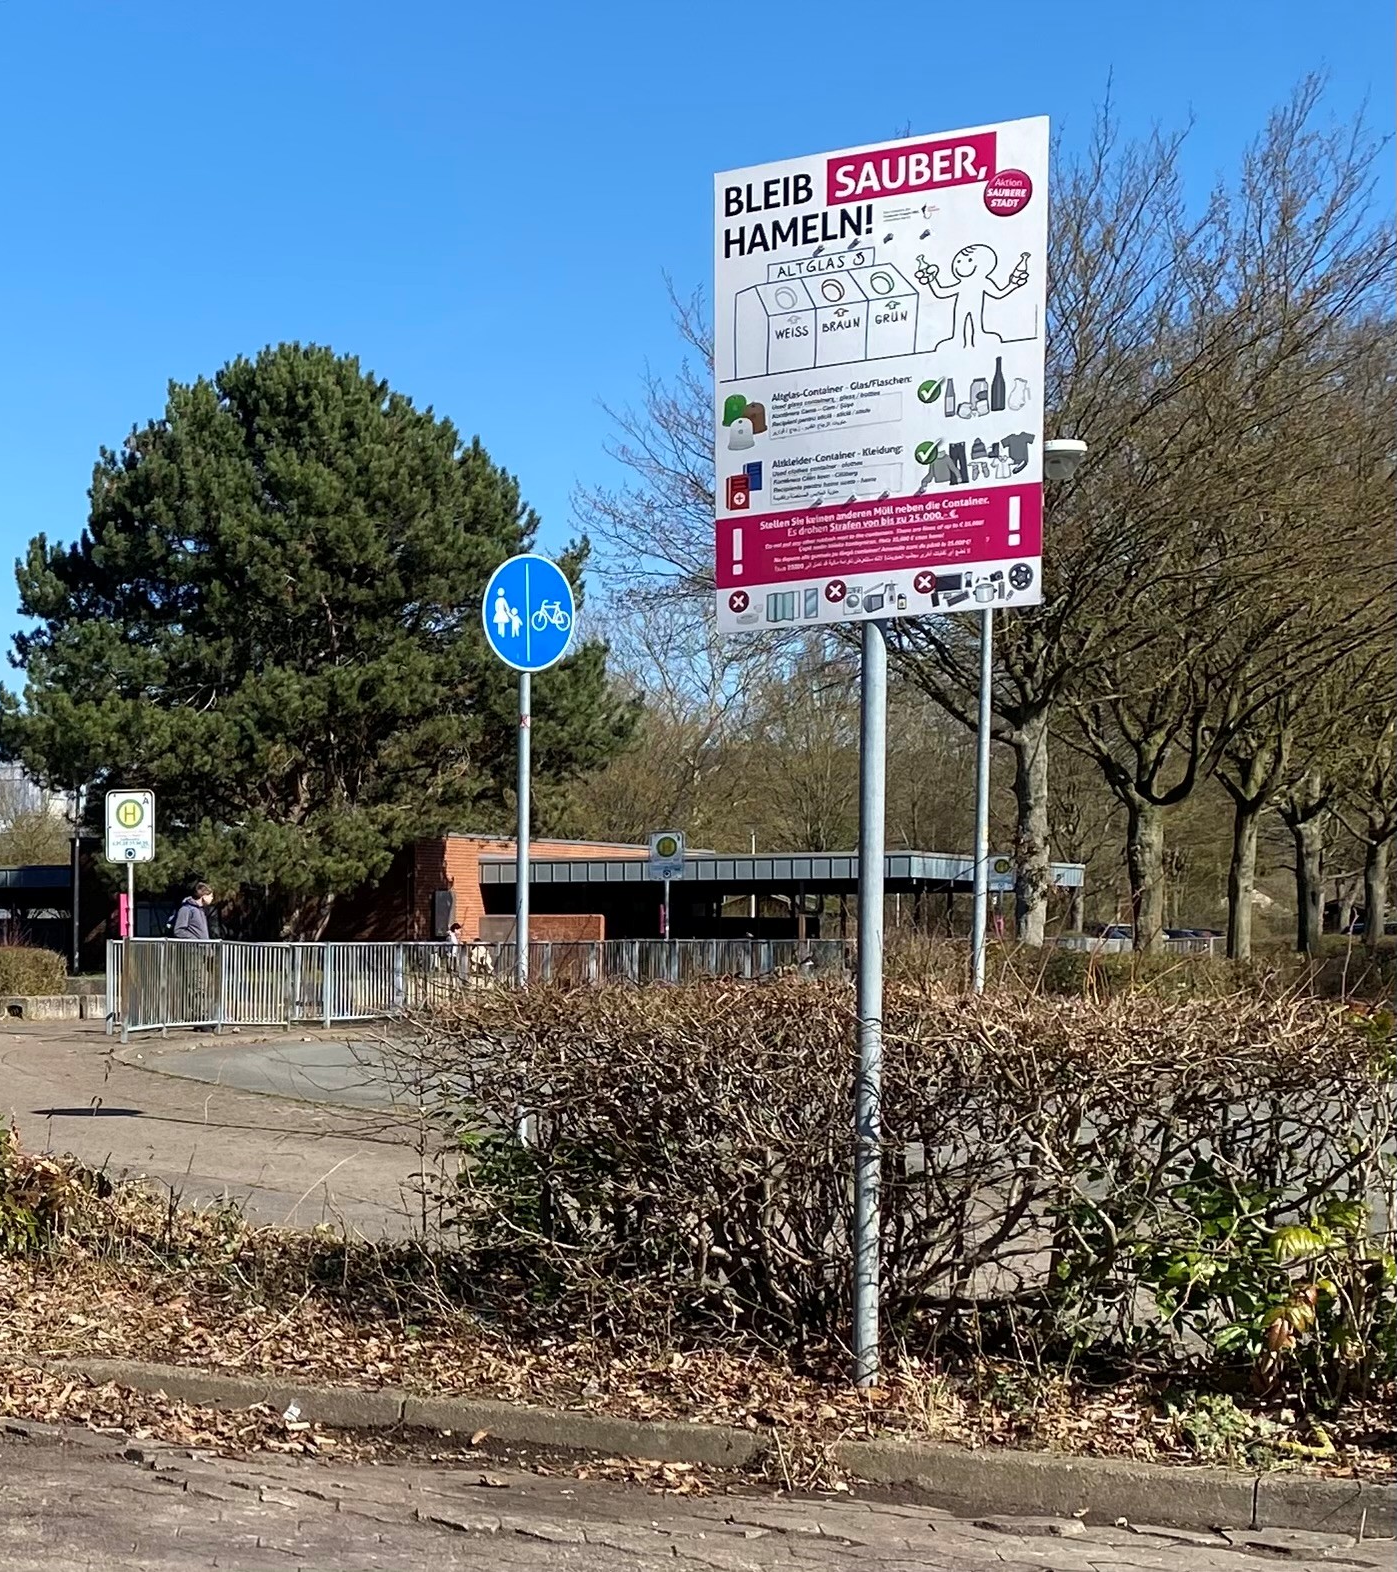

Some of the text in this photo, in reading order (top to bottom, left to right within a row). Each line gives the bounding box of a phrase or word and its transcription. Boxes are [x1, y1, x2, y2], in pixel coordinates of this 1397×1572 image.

[724, 145, 988, 218] BLEIB SAUBER,
[994, 178, 1023, 187] Aktion
[986, 188, 1028, 197] SAUBERE
[990, 198, 1020, 208] STADT
[724, 204, 874, 259] HAMELN!
[777, 255, 845, 278] ALTGLAS
[775, 325, 809, 340] WEISS
[822, 317, 861, 333] BRAUN
[771, 385, 844, 403] Altglas-Container
[850, 376, 913, 391] Glas/Flaschen:
[771, 451, 856, 469] Altkleider-Container
[862, 445, 904, 456] Kleidung:
[760, 497, 990, 530] Stellen Sie keinen anderen Müll neben die Container.
[787, 528, 797, 537] Es
[798, 525, 828, 535] drohen
[829, 520, 862, 531] Strafen
[881, 517, 895, 526] bis
[897, 516, 907, 524] zu
[124, 804, 135, 822] H
